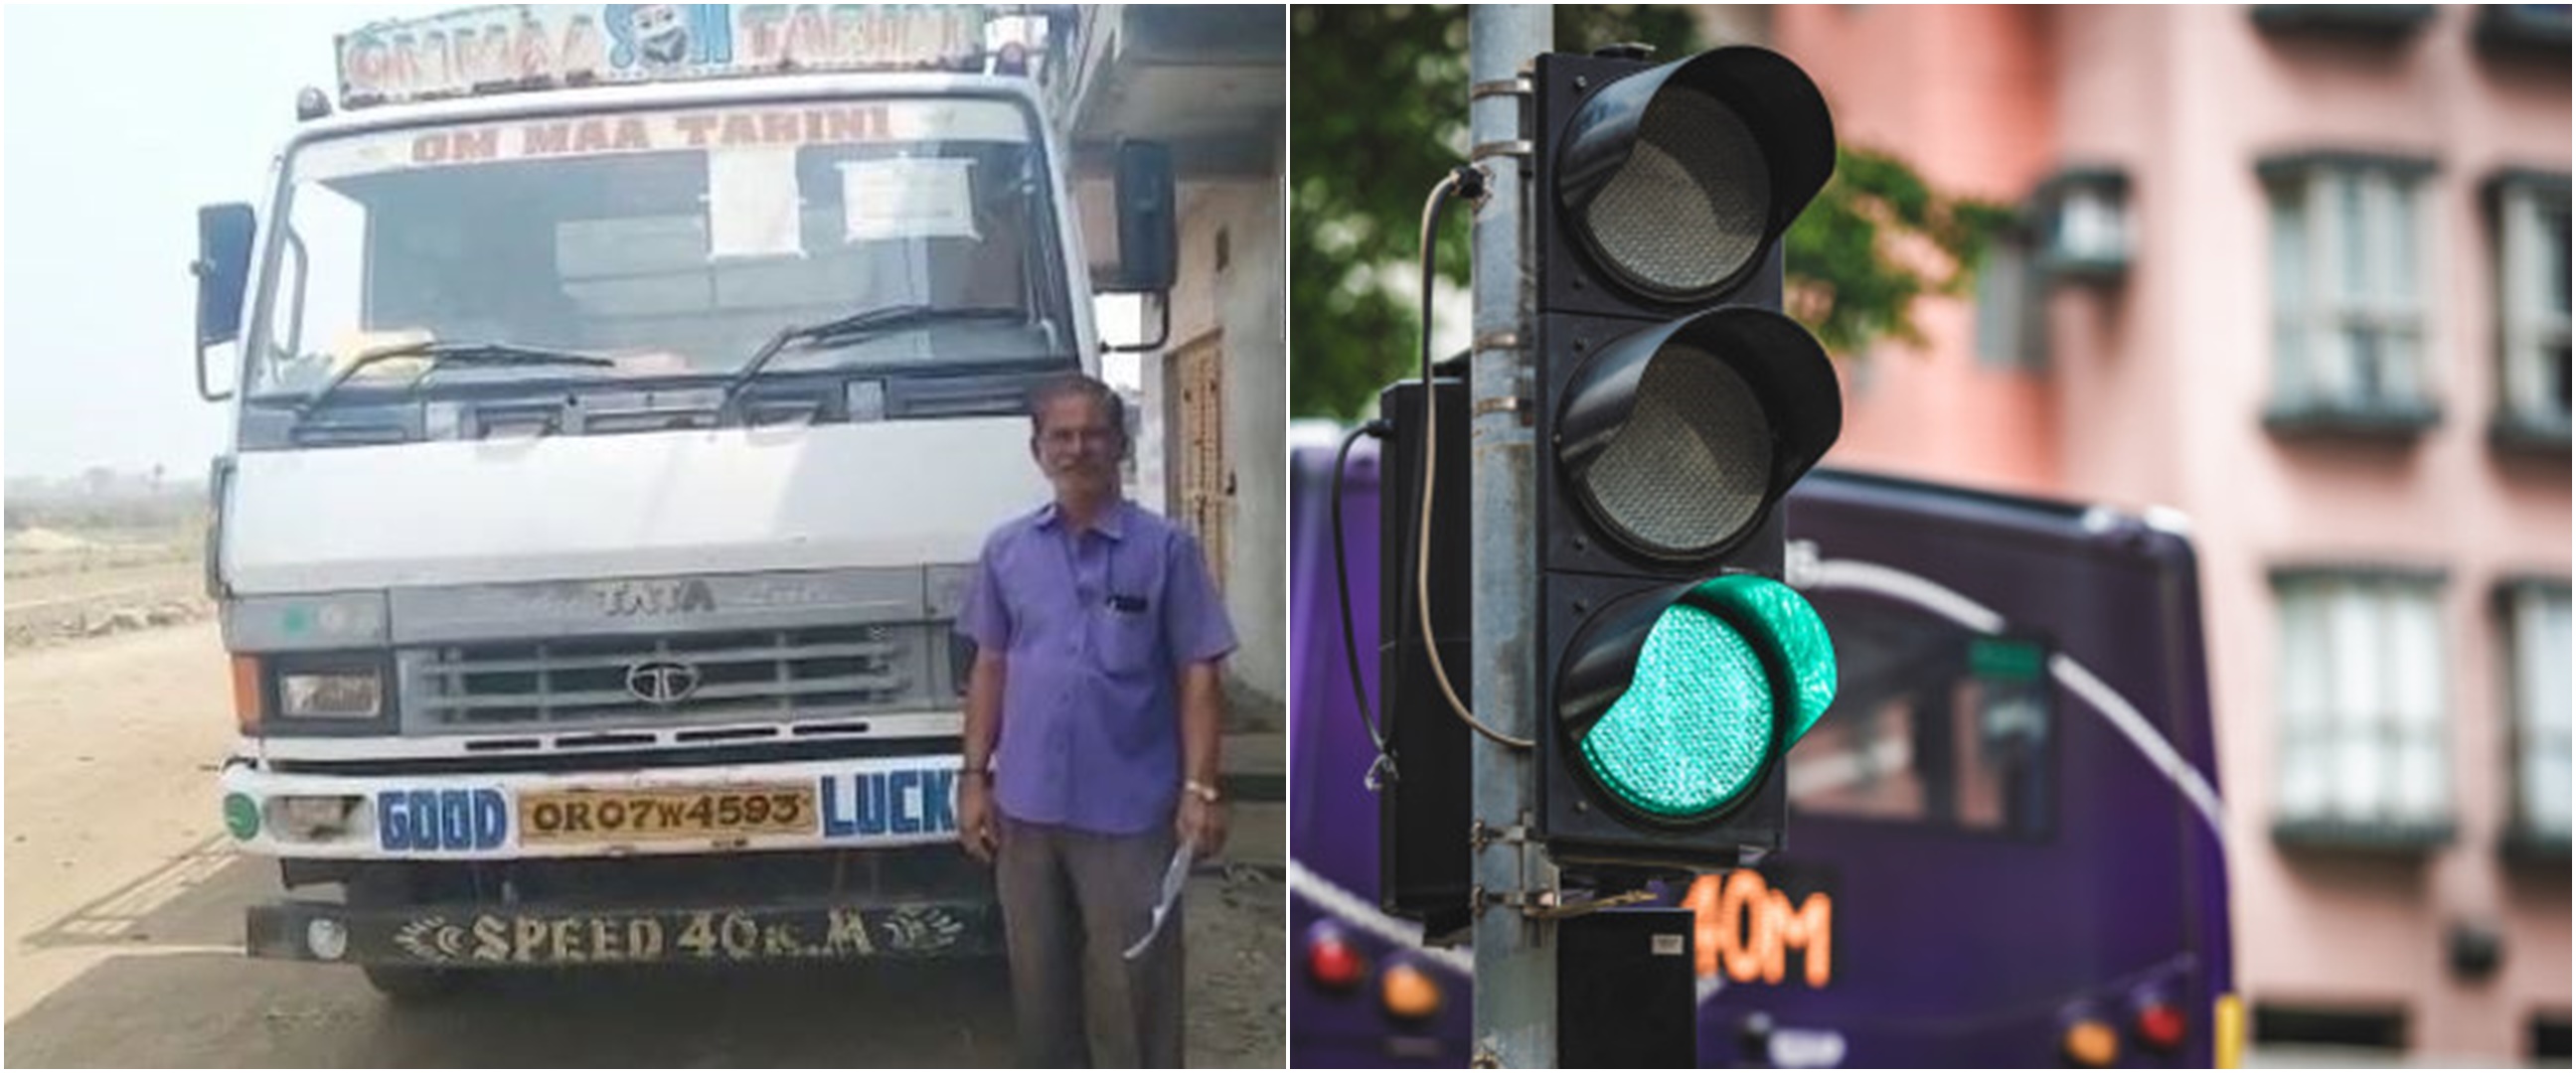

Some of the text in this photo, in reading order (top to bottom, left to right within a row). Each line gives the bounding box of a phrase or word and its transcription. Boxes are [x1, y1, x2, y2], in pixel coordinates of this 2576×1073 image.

[412, 105, 890, 162] OM MAA TARINI
[378, 789, 508, 850] GOOD
[821, 769, 957, 838] LUCK
[472, 912, 664, 962] SPEED
